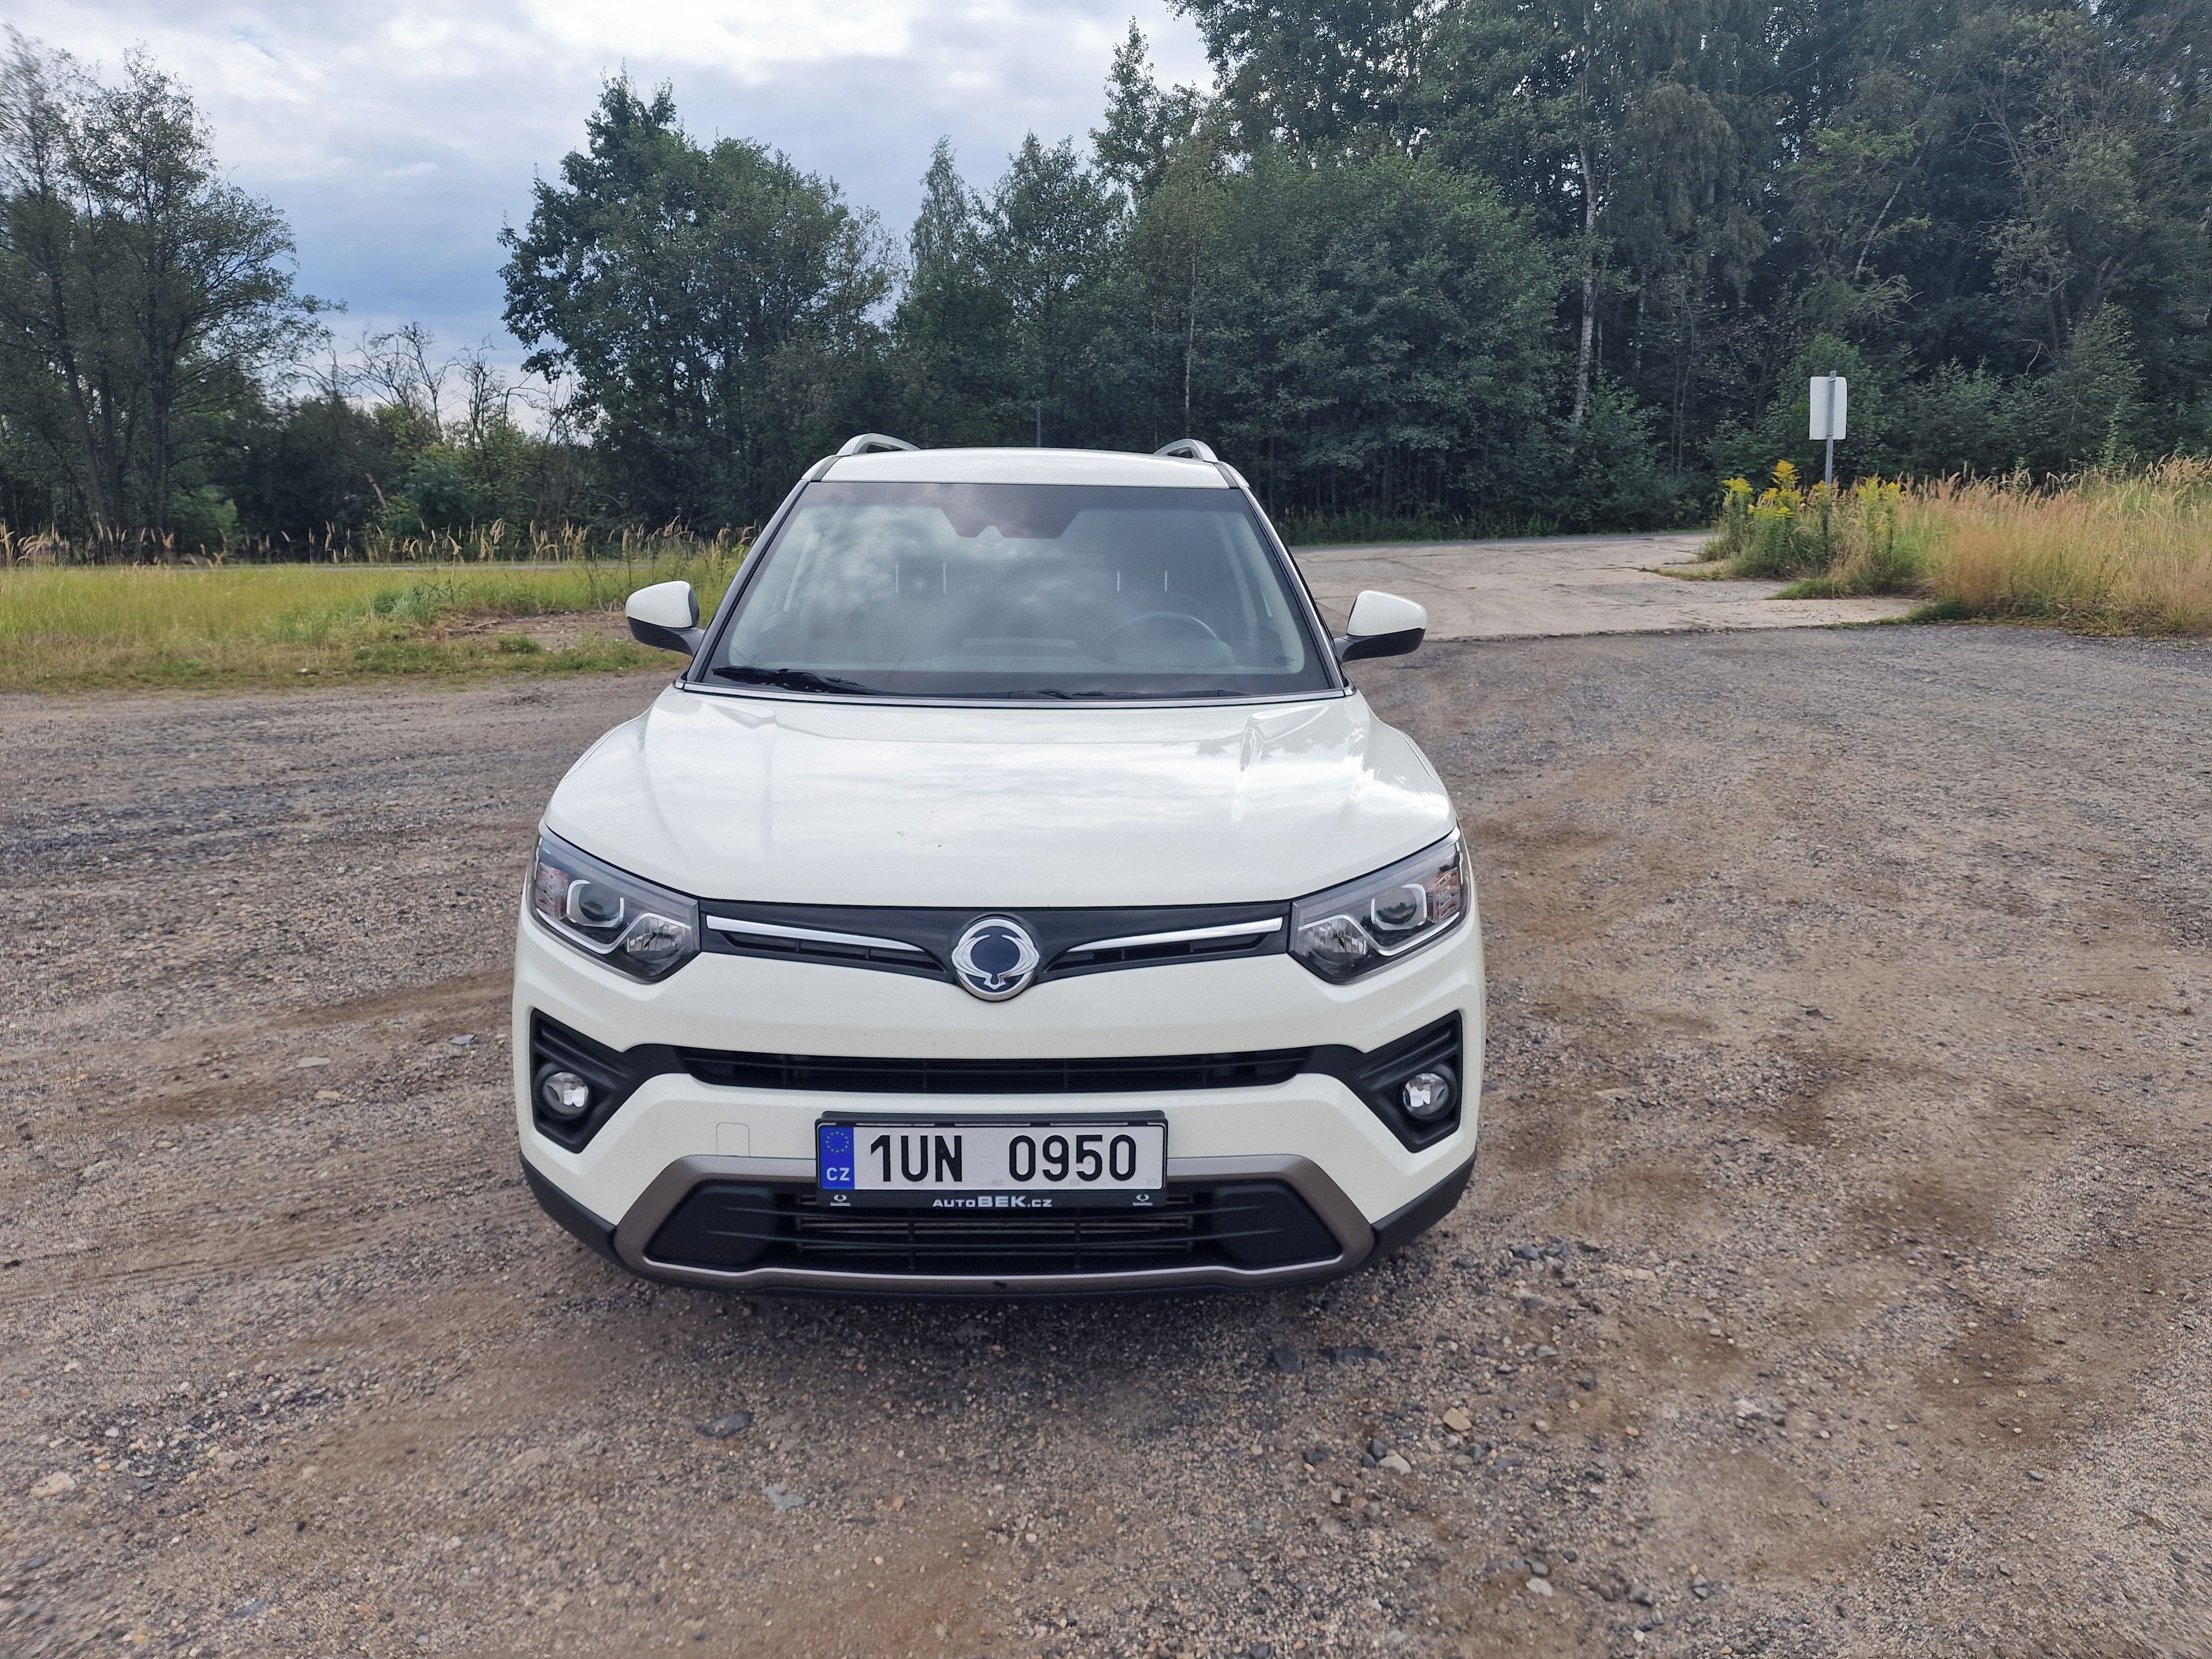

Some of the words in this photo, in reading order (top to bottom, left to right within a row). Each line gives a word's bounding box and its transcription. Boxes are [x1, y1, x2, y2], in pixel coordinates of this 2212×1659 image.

[870, 1135, 962, 1182] 1UN
[1009, 1134, 1136, 1182] 0950
[826, 1167, 850, 1181] CZ
